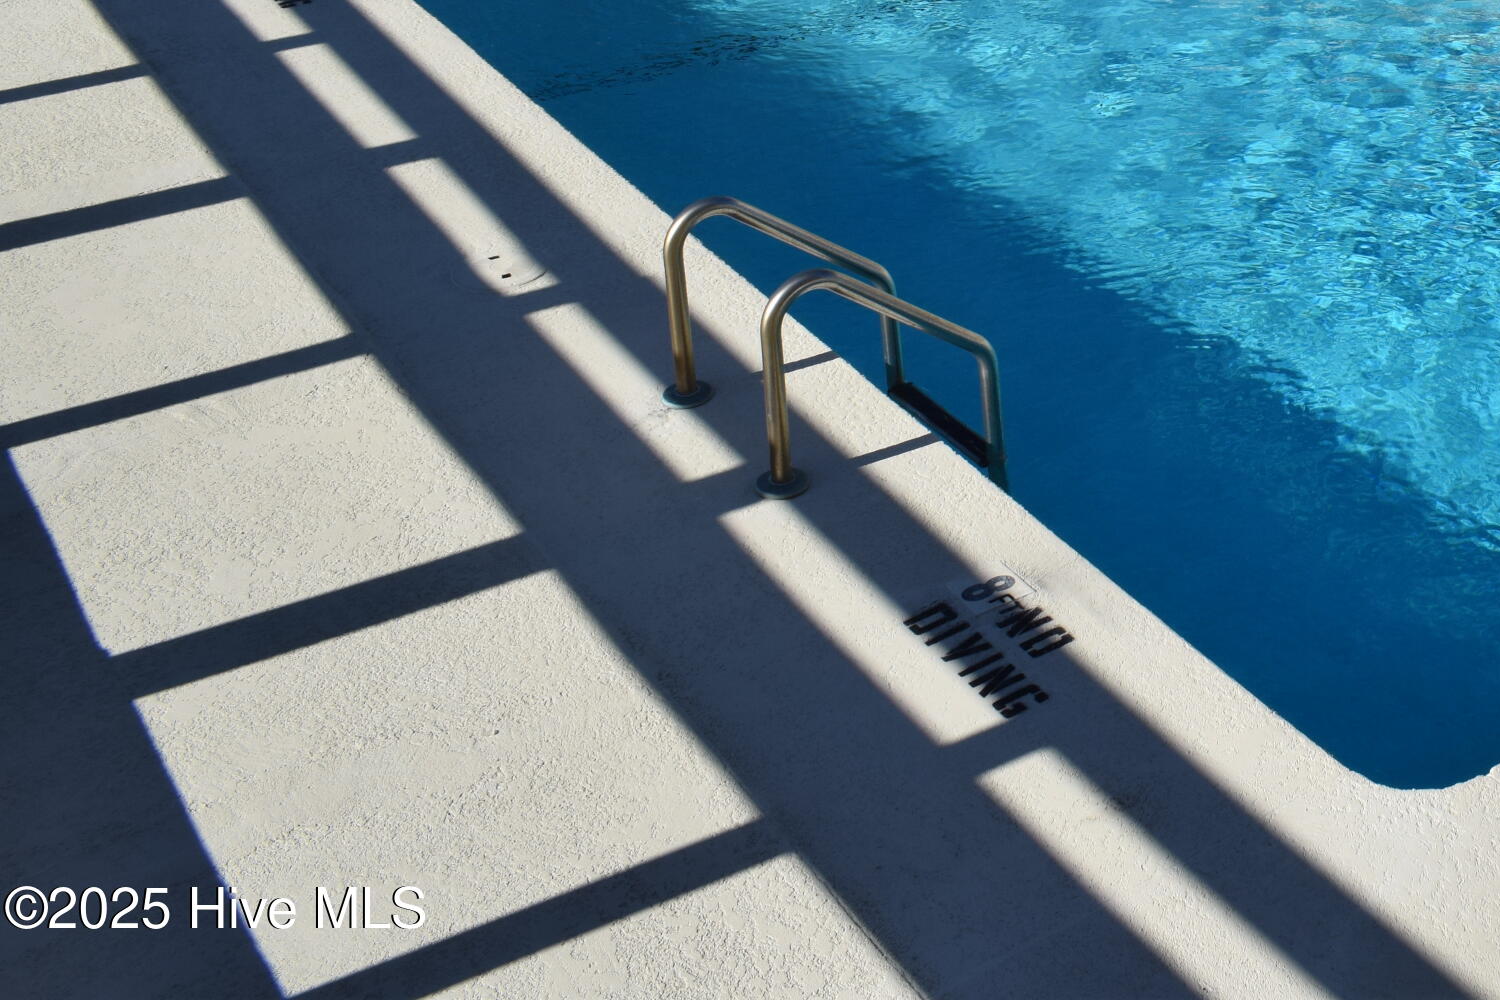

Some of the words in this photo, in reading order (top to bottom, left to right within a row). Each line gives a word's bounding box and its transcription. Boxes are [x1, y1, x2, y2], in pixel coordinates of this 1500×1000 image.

[902, 602, 1050, 719] DIVING
[961, 574, 1016, 602] 8
[995, 606, 1075, 658] NO
